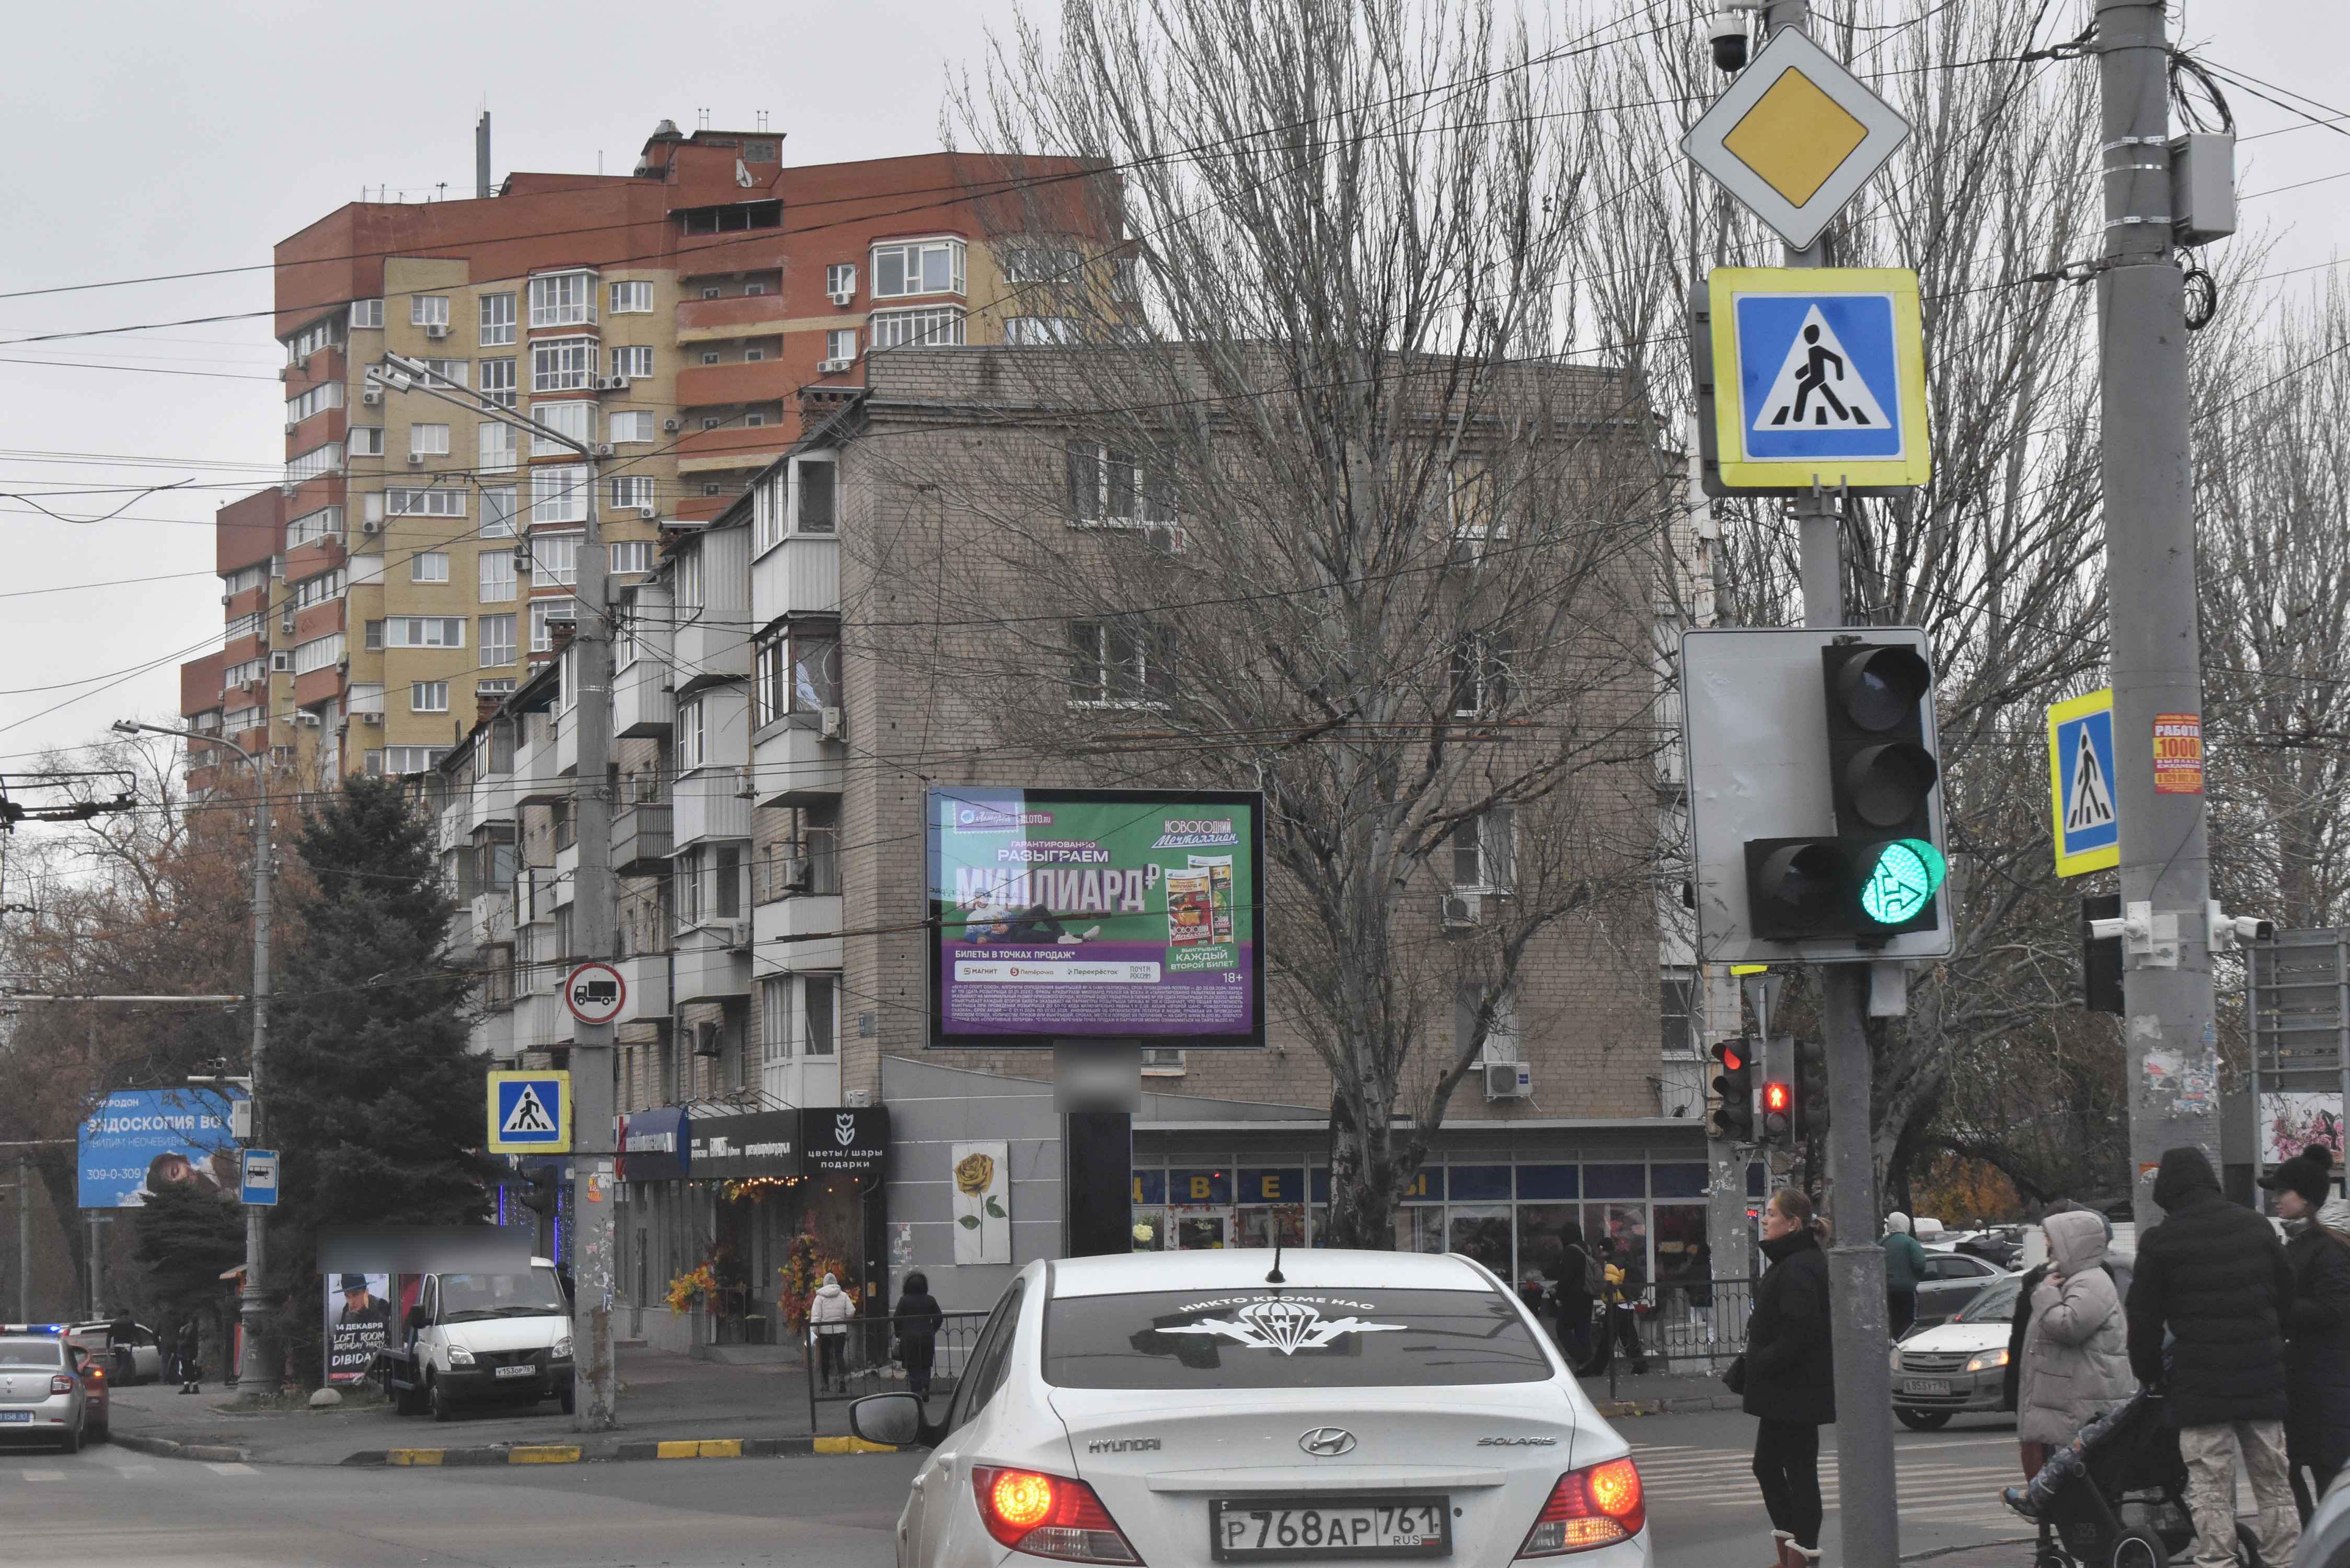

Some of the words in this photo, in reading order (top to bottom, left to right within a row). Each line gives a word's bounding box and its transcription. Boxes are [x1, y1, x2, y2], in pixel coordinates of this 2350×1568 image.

[2155, 725, 2200, 737] РАБОТА
[1165, 818, 1231, 834] НОВОГОДНИЙ
[997, 849, 1109, 862] РАЗЫГРАЕМ
[955, 950, 989, 959] БИЛЕТЫ
[1176, 950, 1228, 961] КАЖДЫЙ
[1171, 961, 1204, 970] ВТОРОЙ
[1223, 972, 1243, 983] 18+
[128, 1136, 192, 1146] НЕОЧЕВИДНО
[87, 1168, 141, 1180] 309-0-309
[1179, 1297, 1248, 1312] НИКТО
[1252, 1296, 1327, 1304] КРОМЕ
[1330, 1298, 1376, 1310] НАС
[345, 1322, 383, 1331] ДЕКАБРЯ
[333, 1333, 355, 1344] LOFT
[360, 1331, 385, 1342] ROOM
[333, 1342, 364, 1351] BIRTHDAY
[332, 1352, 376, 1367] DIBIDA
[1089, 1437, 1161, 1454] HYUNDAI
[1477, 1436, 1559, 1446] SOLARIS
[1392, 1535, 1420, 1546] RUS
